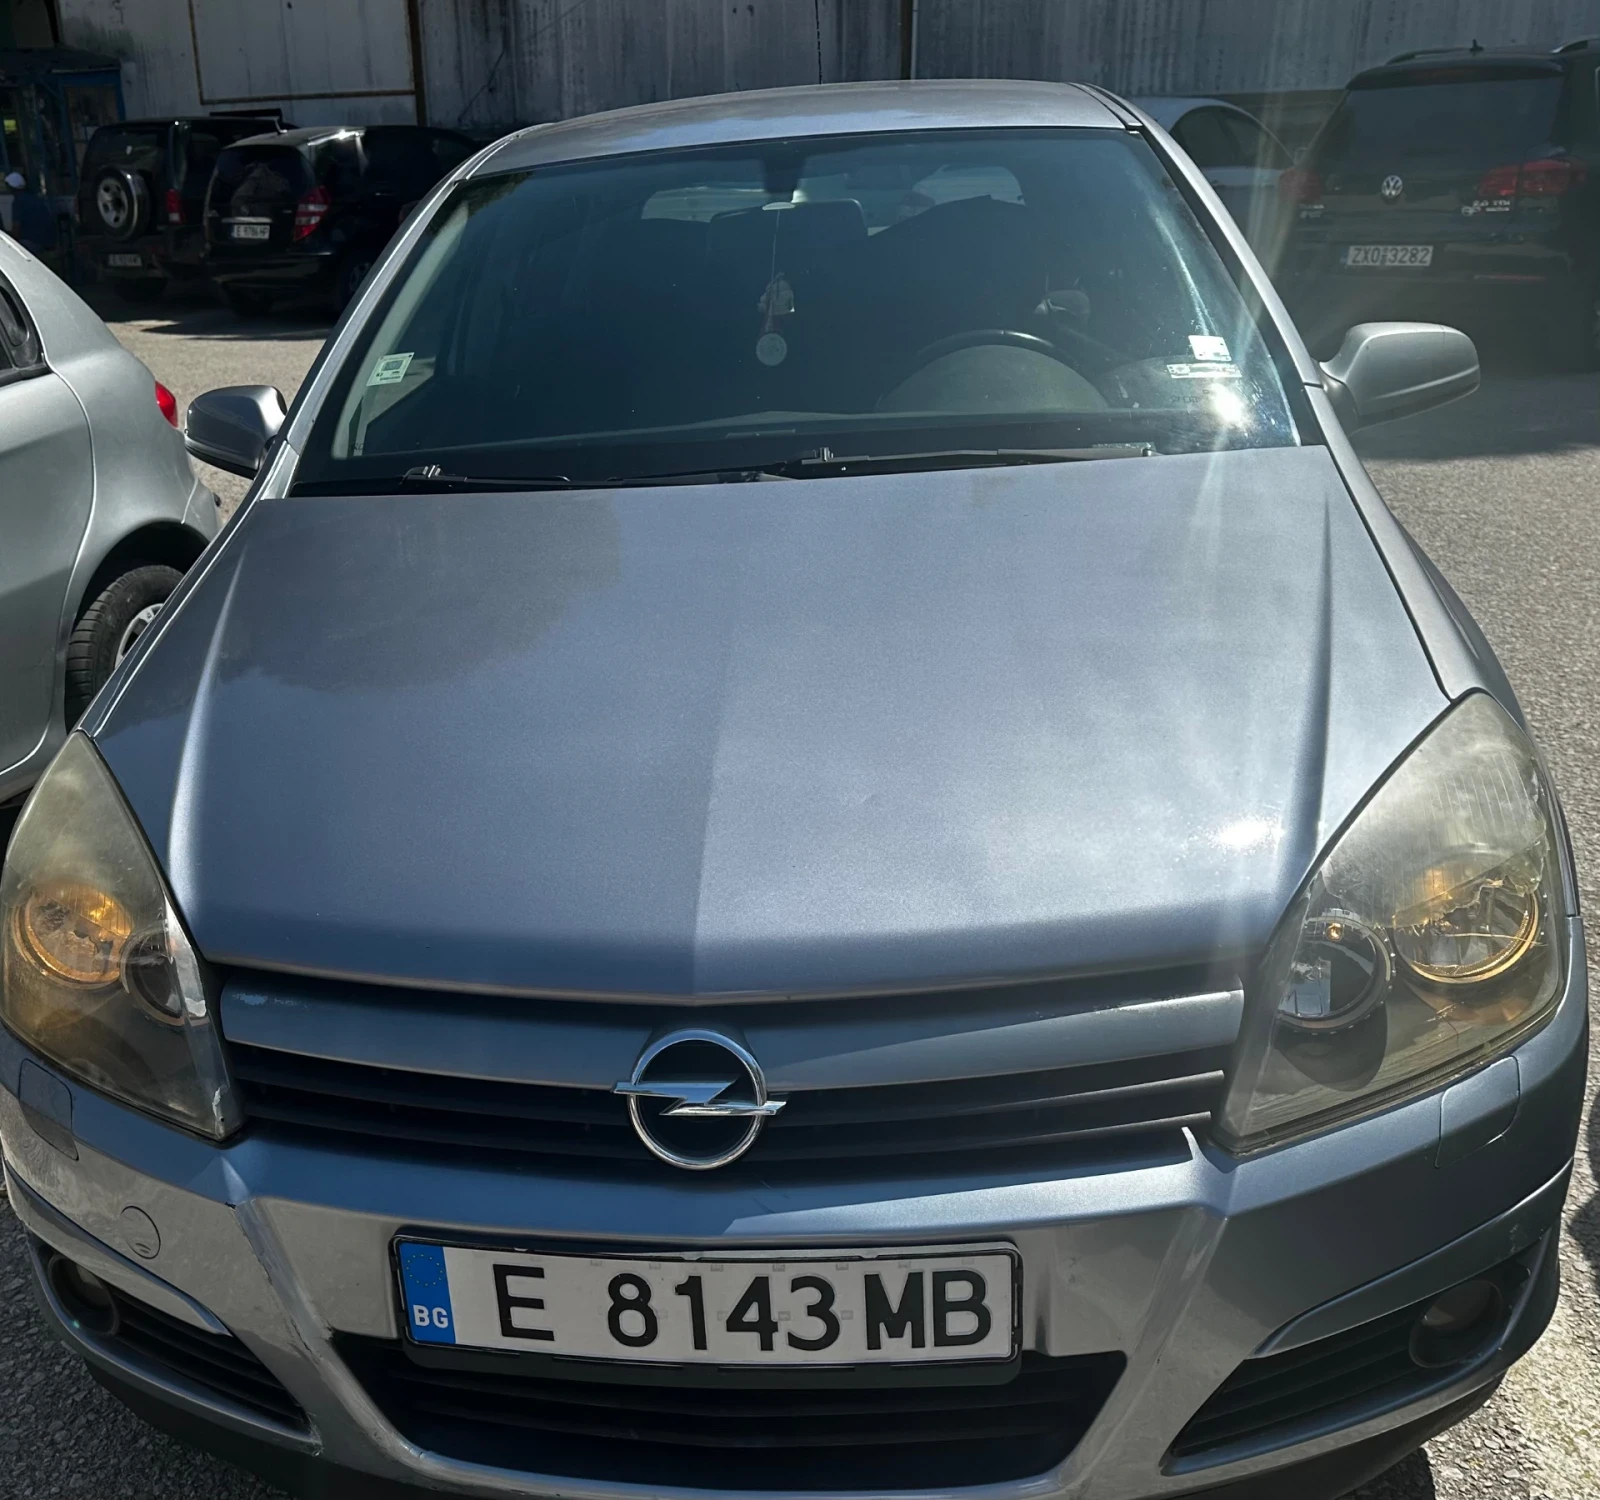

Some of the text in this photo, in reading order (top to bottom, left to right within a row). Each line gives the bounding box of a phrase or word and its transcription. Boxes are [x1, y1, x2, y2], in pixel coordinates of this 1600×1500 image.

[413, 1304, 449, 1329] BG
[493, 1263, 993, 1352] E 8143 MB
